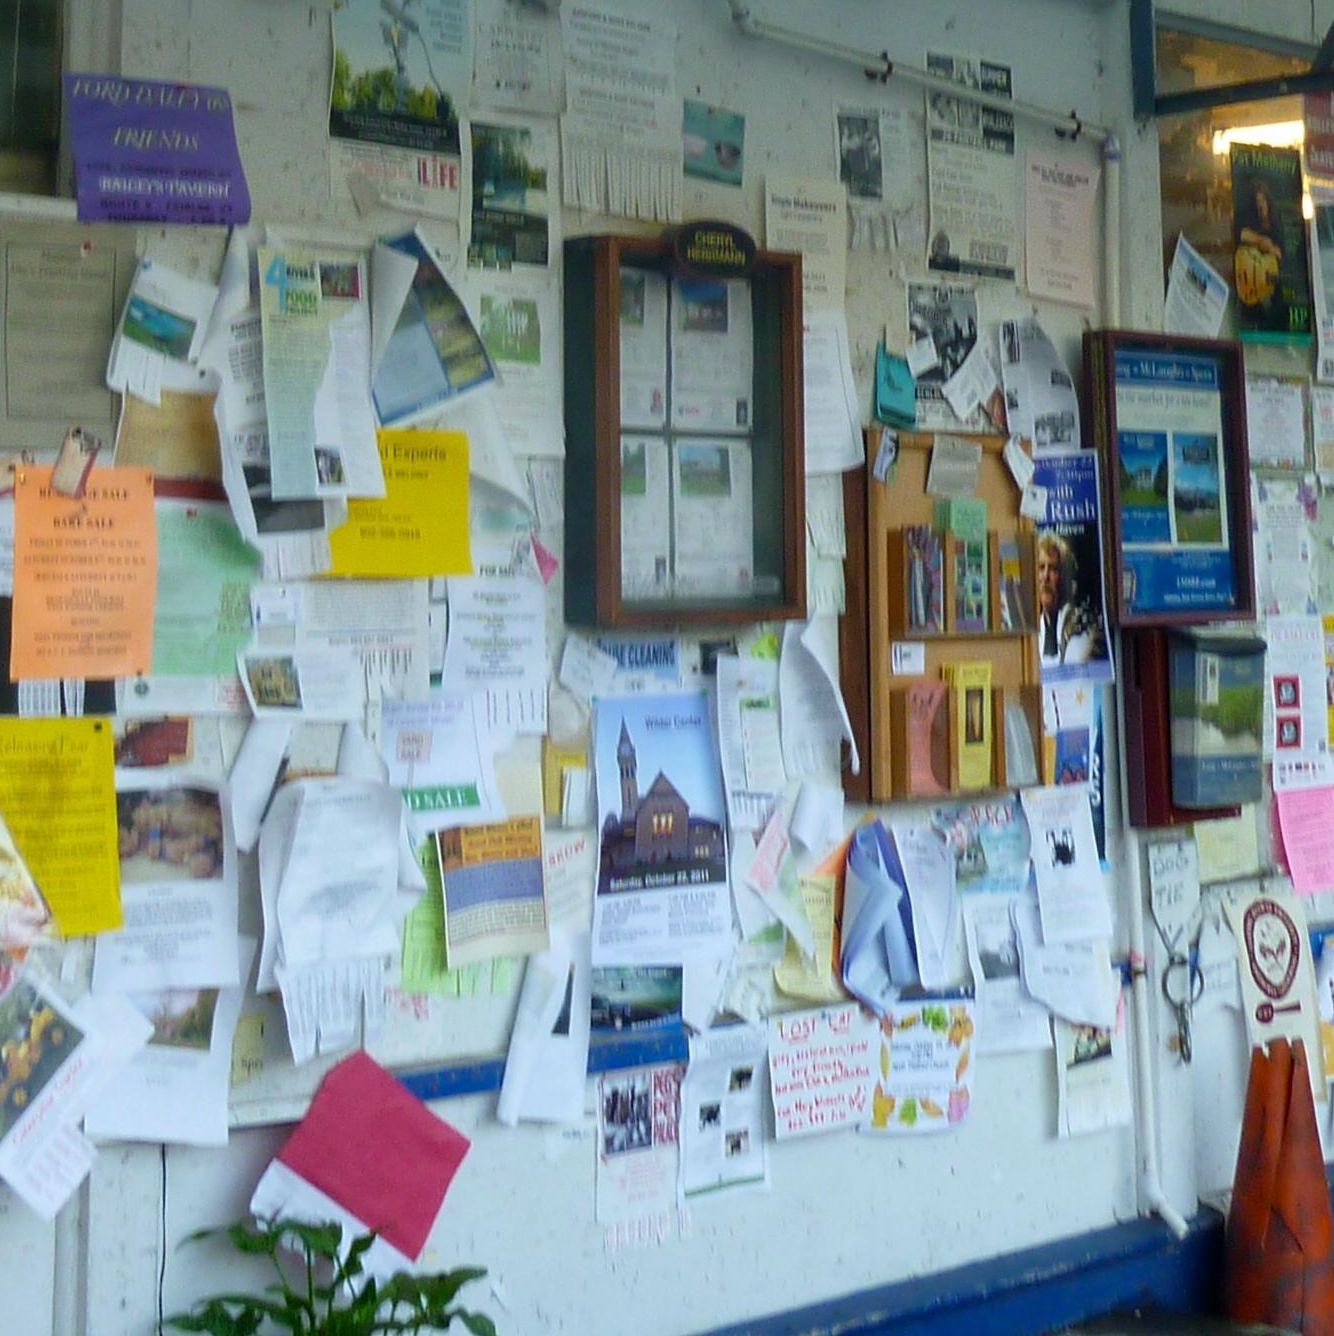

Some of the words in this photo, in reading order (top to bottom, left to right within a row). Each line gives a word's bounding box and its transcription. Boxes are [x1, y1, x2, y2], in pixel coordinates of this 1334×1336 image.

[265, 254, 287, 313] 4
[1051, 500, 1096, 521] Rush
[628, 639, 677, 667] CLEANING
[426, 790, 466, 809] SALE
[778, 1019, 817, 1044] LOST
